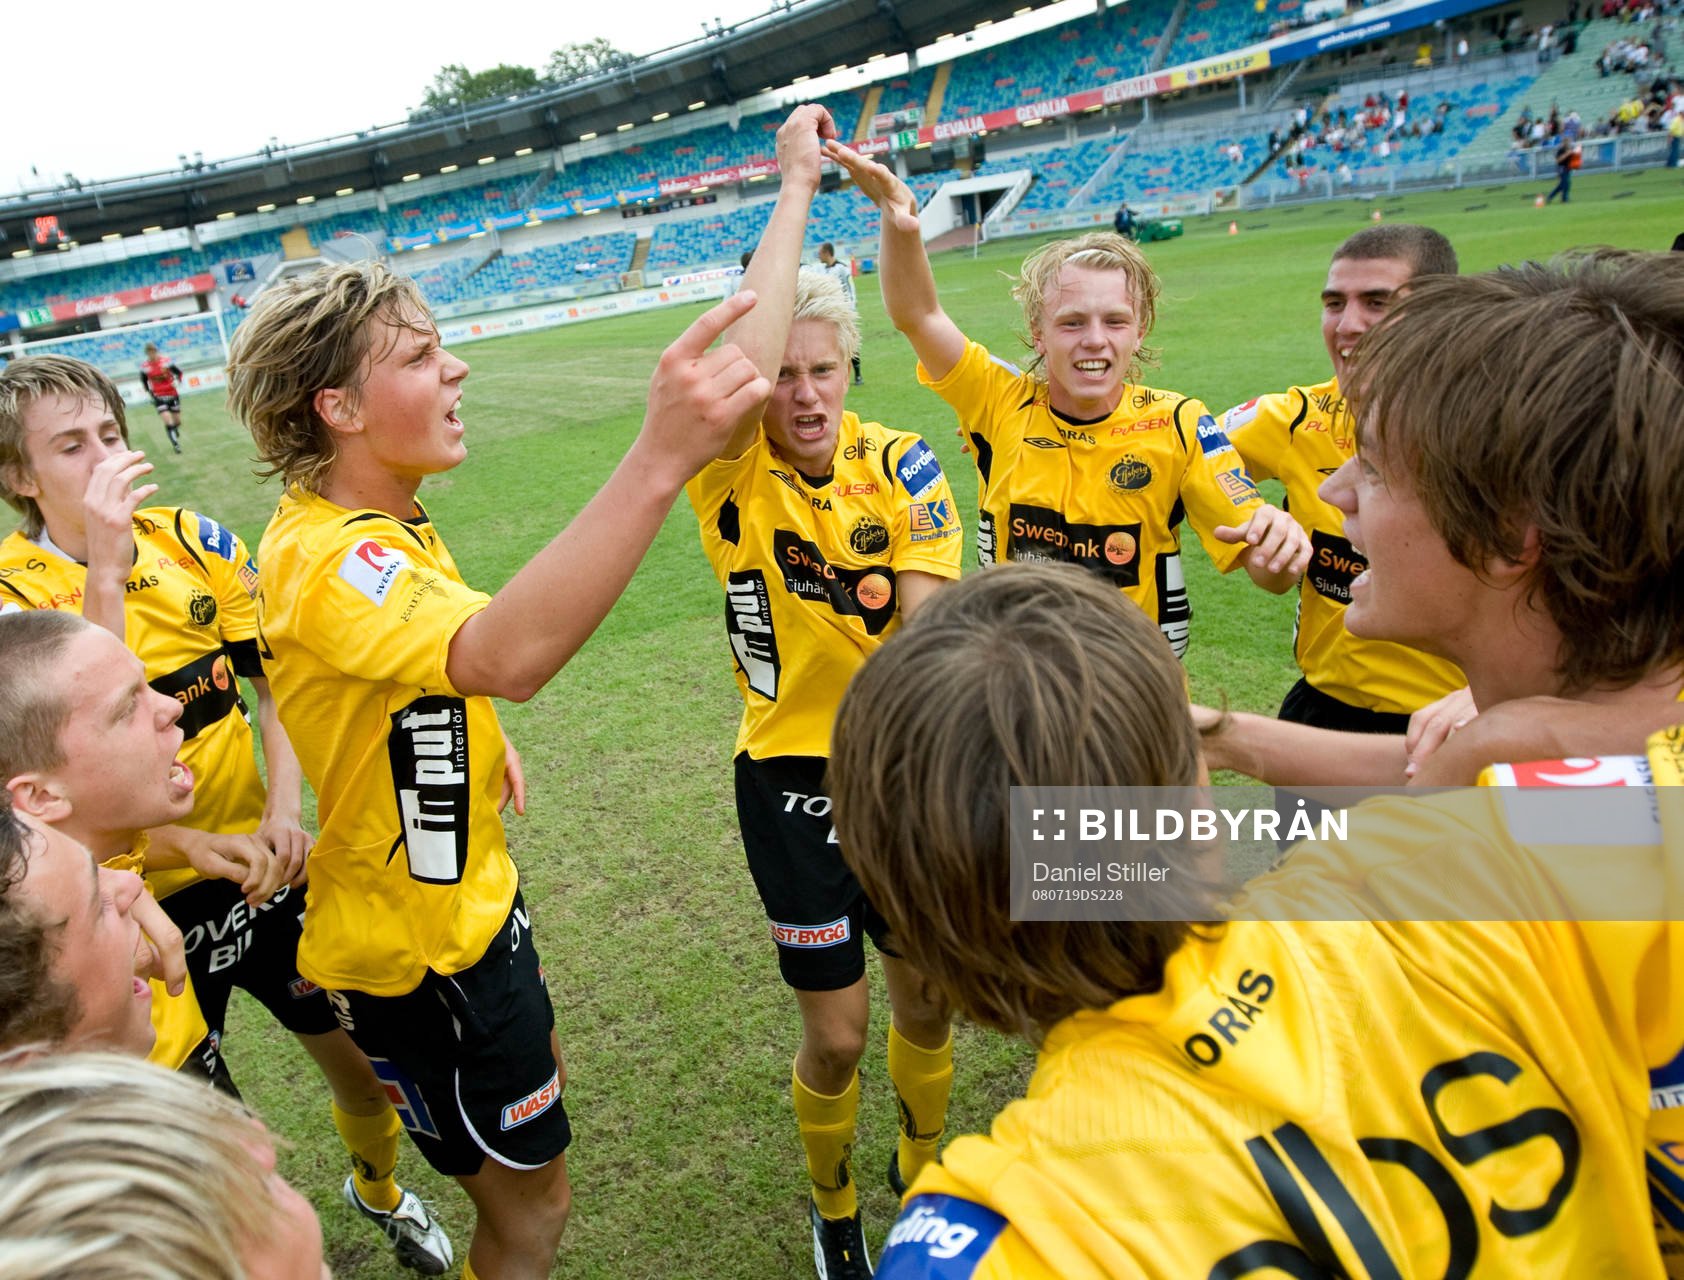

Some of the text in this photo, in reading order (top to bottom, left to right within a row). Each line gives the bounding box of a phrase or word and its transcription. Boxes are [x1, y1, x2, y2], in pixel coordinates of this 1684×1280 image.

[1200, 55, 1254, 78] TULIP
[1103, 77, 1158, 103] GEVALIA
[1016, 98, 1070, 122] GEVALIA
[933, 116, 986, 140] GEVALIA
[1110, 416, 1171, 437] PULSEN
[454, 706, 465, 769] interiör
